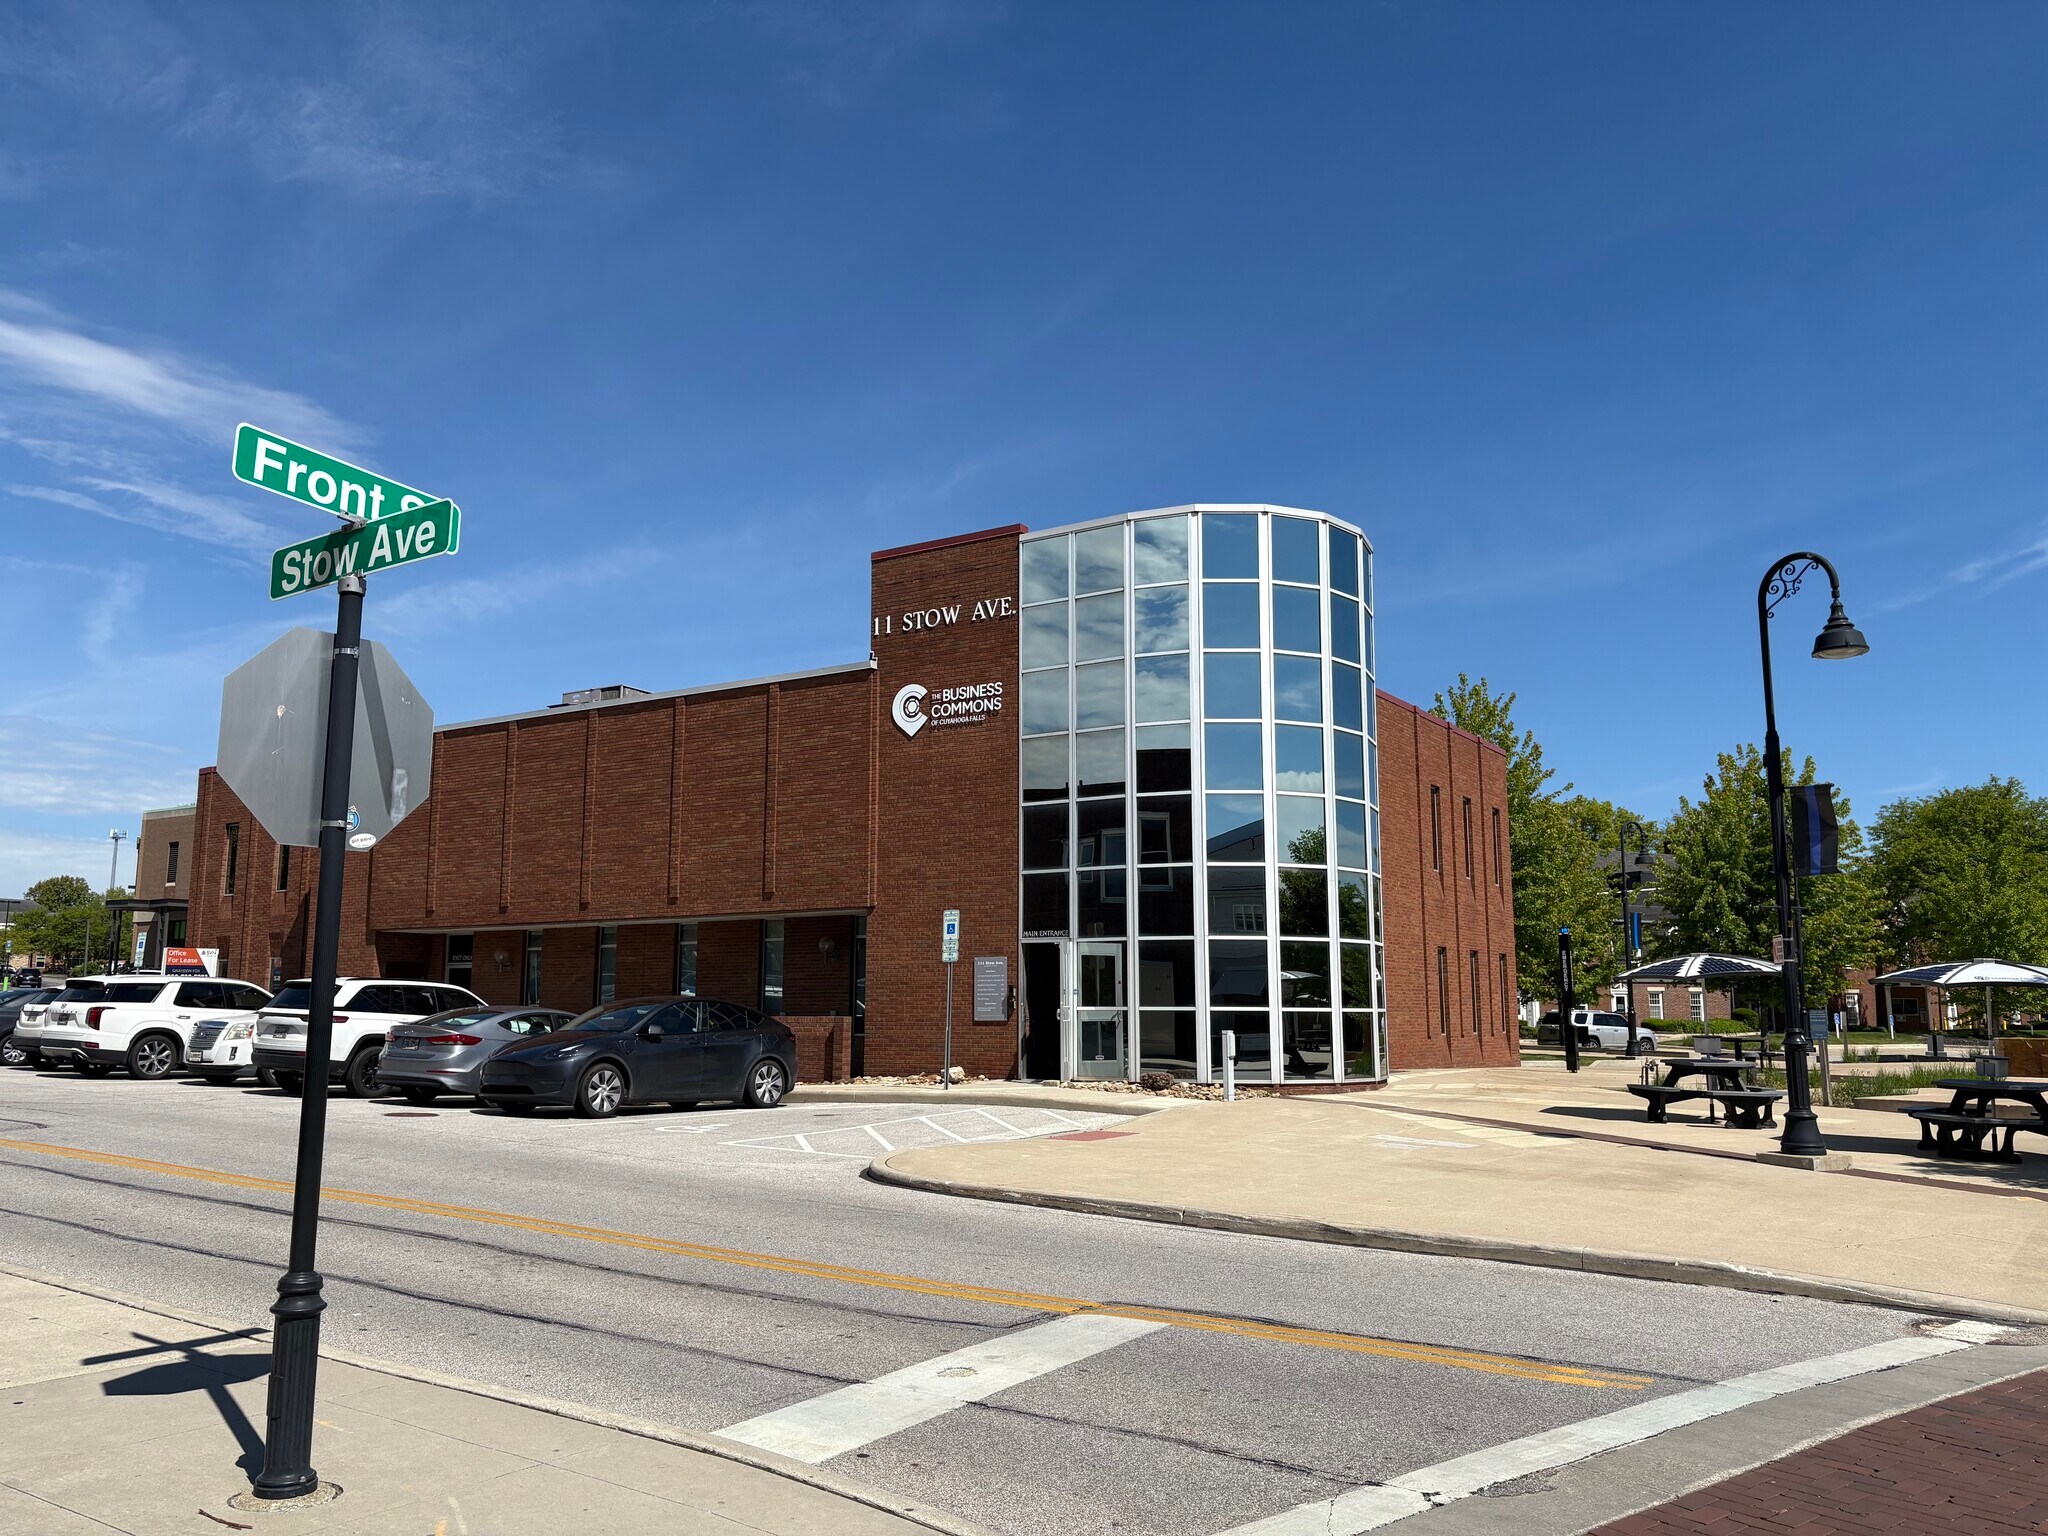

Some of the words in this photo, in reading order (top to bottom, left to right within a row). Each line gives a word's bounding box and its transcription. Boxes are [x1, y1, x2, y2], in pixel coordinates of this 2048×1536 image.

[253, 437, 385, 521] Front
[281, 541, 359, 592] Stow
[368, 520, 436, 568] Ave
[873, 615, 892, 636] 11
[902, 604, 962, 631] STOW
[971, 596, 1017, 621] AVE.
[942, 681, 1003, 702] BUSINESS
[931, 697, 1002, 718] COMMONS
[939, 716, 969, 725] CUYAHOGA
[969, 714, 986, 722] FALLS
[1039, 929, 1069, 937] ENTRANCE
